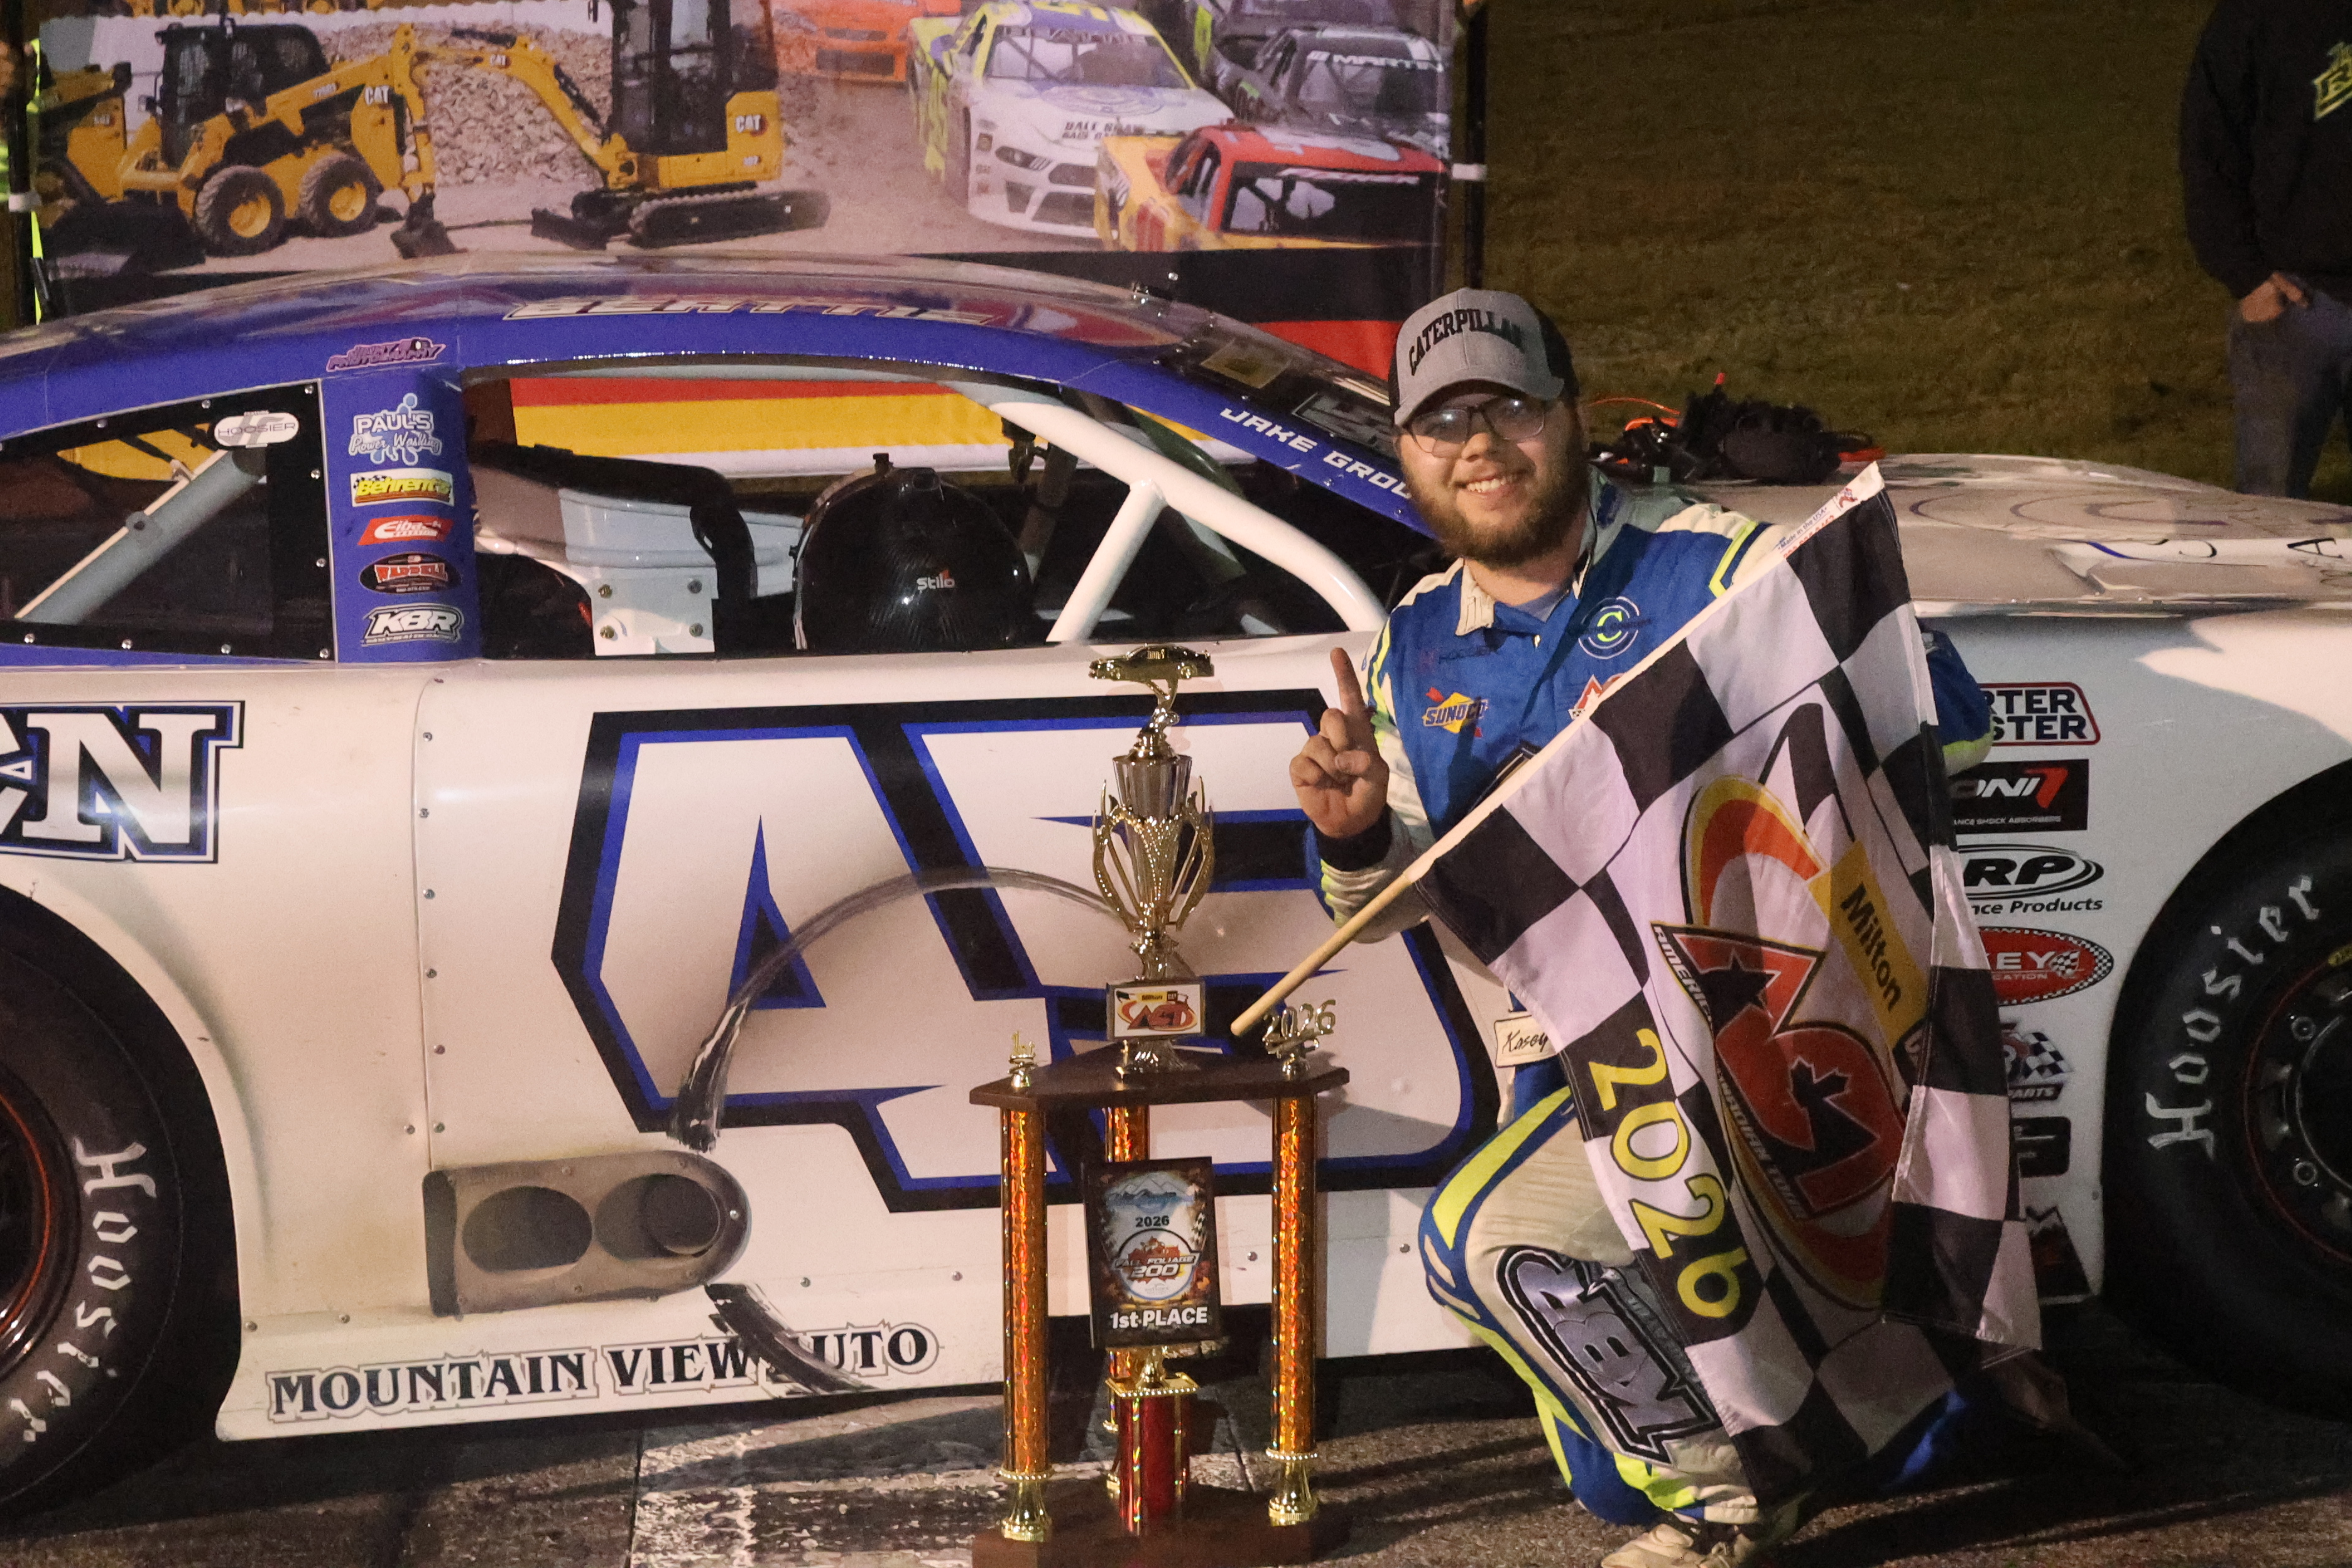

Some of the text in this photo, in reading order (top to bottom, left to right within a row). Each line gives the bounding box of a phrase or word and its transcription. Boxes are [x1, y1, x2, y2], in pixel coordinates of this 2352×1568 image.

[364, 85, 390, 106] CAT
[734, 114, 762, 133] CAT
[1408, 308, 1525, 376] CATERPILLAR
[217, 422, 296, 437] HOOSIER
[1220, 408, 1317, 453] JAKE
[916, 572, 956, 591] Stilo
[371, 609, 457, 634] KBR
[1424, 699, 1488, 726] SUNOCO
[2010, 897, 2104, 914] Products
[1840, 881, 1902, 1013] Milton
[1985, 951, 2056, 970] EY
[2145, 874, 2319, 1160] Hoosier
[1588, 1028, 1748, 1319] 2026
[1135, 1216, 1170, 1228] 2026
[1131, 1263, 1180, 1278] 200
[10, 1136, 157, 1442] Hoosier
[1111, 1306, 1208, 1329] 1st PLACE
[273, 1351, 588, 1418] MOUNTAIN
[608, 1340, 758, 1388] VIEW
